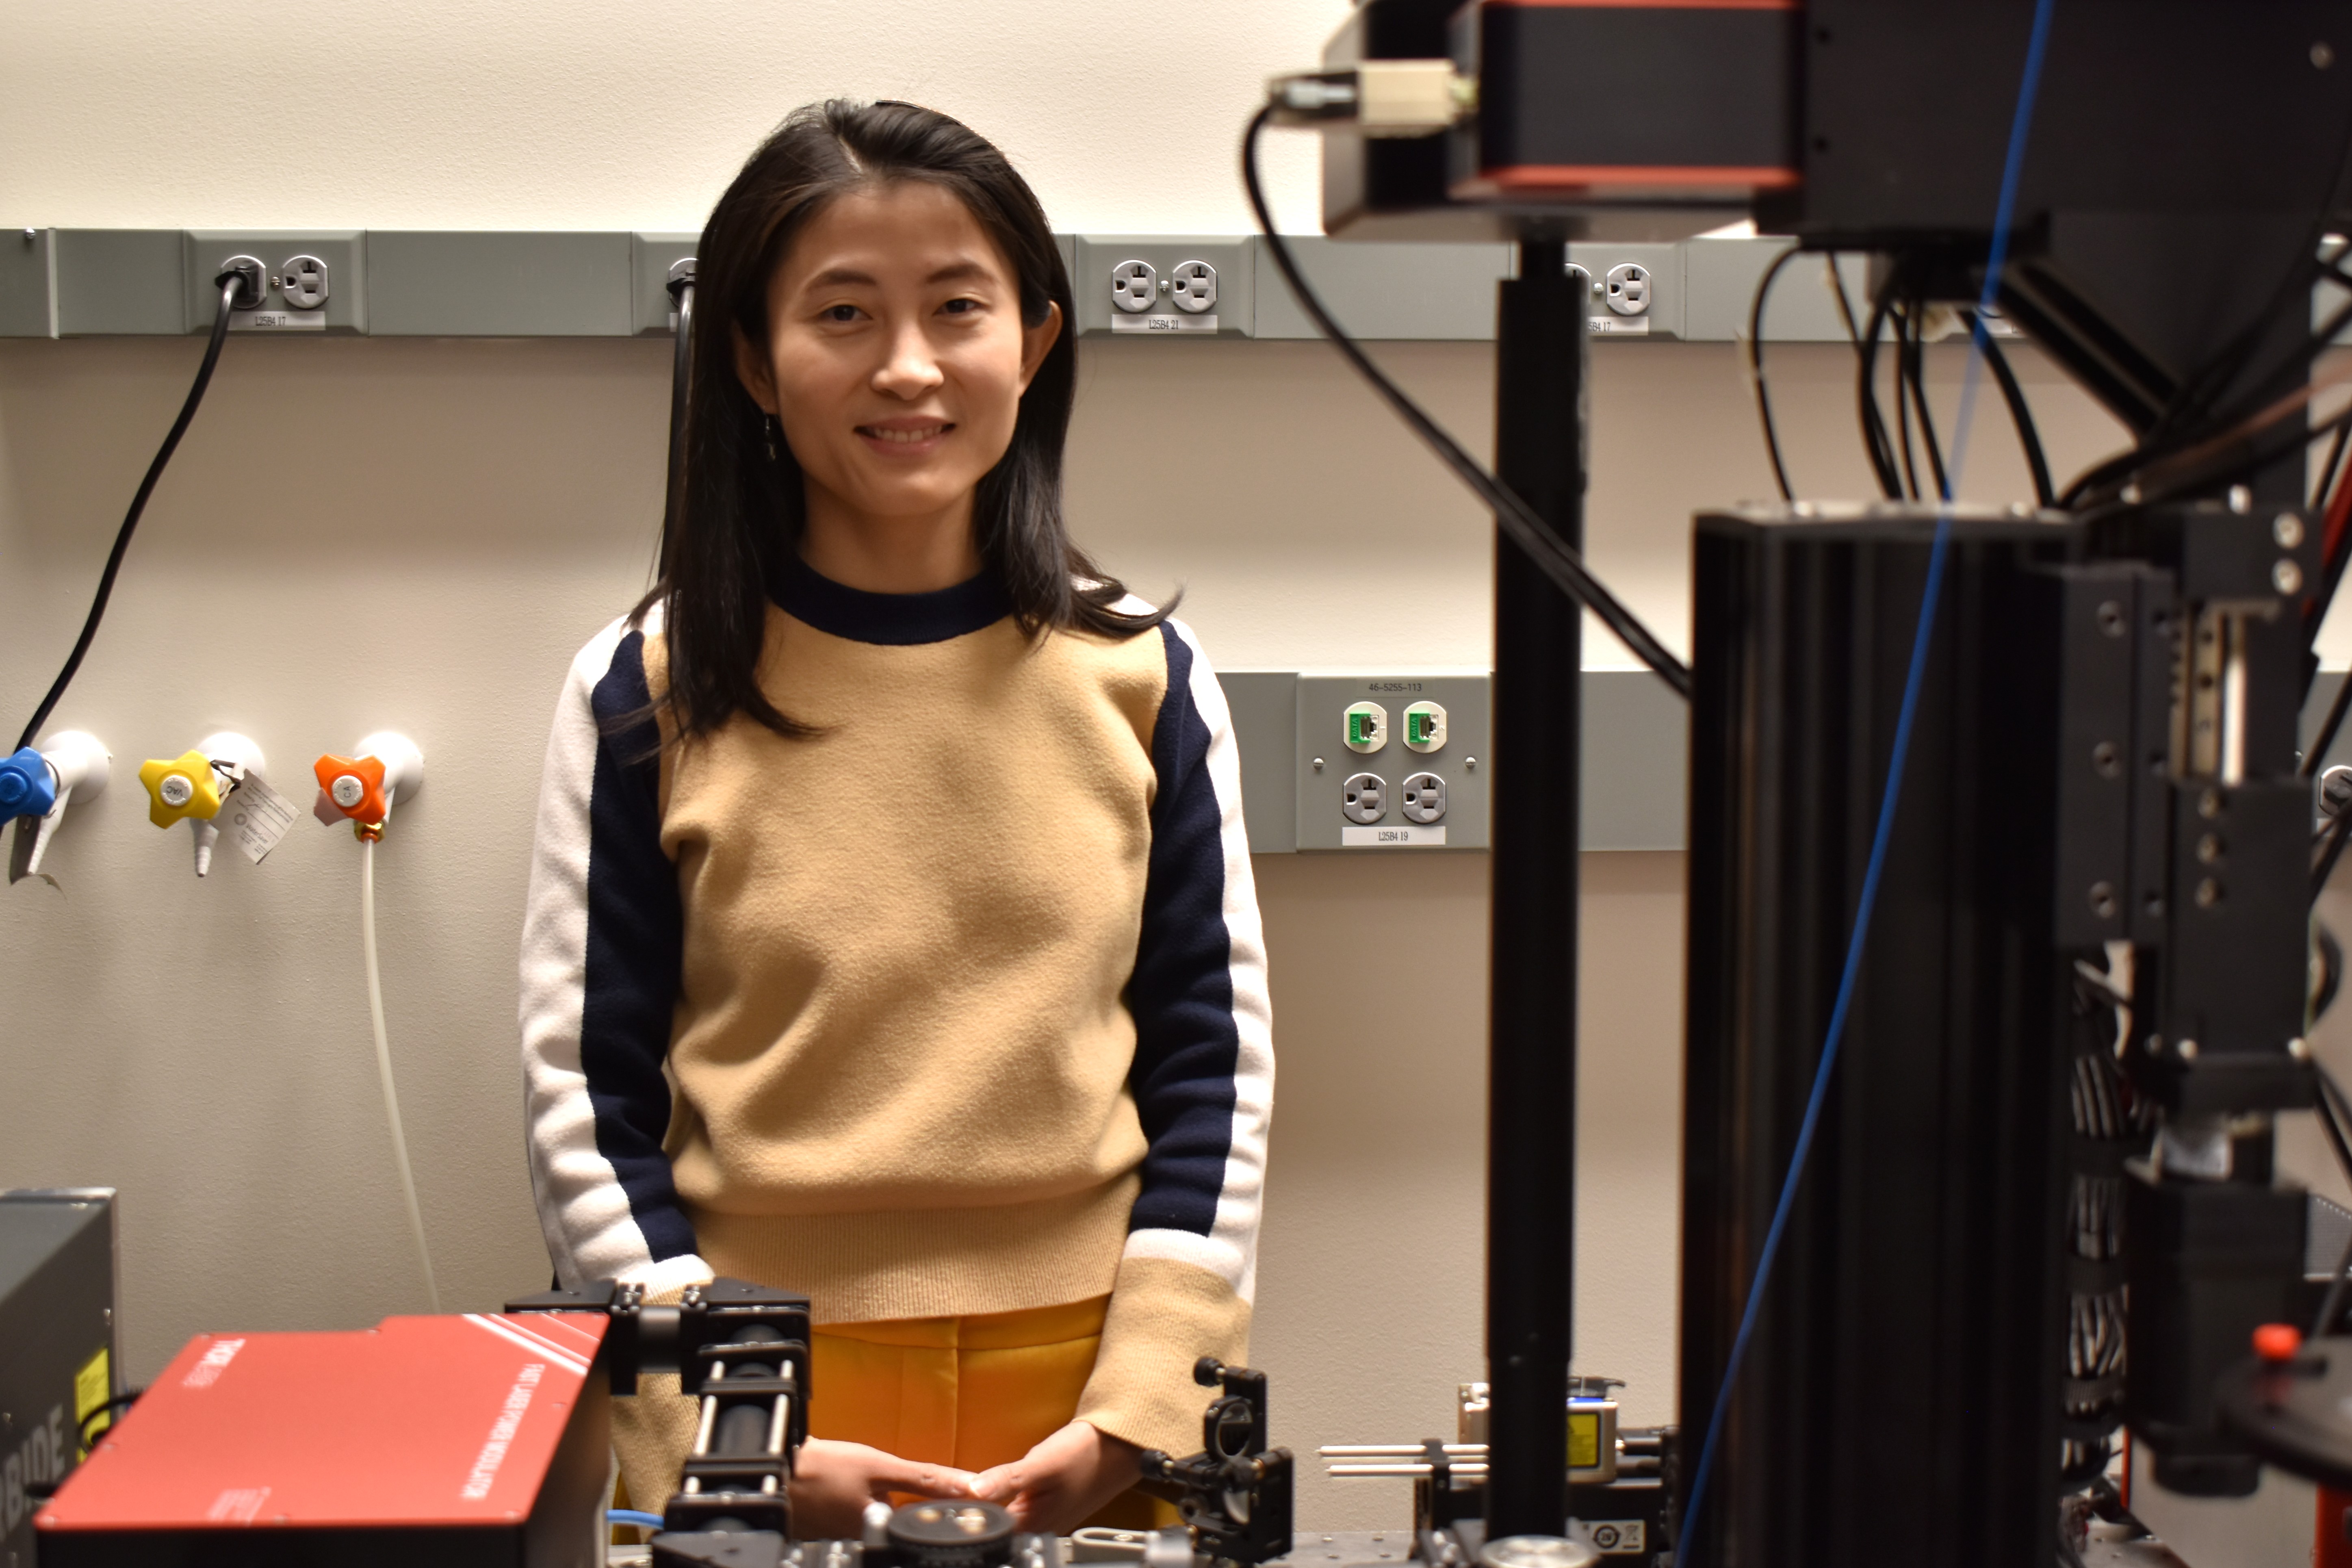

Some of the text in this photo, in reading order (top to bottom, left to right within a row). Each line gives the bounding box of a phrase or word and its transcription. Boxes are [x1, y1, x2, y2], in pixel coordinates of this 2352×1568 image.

[256, 316, 286, 326] L25B4 17
[1149, 320, 1179, 330] L25B4 21
[1603, 322, 1611, 332] 17
[1369, 683, 1422, 691] 46-5255-113
[166, 786, 183, 797] VAC
[1378, 831, 1409, 841] L25B4 19
